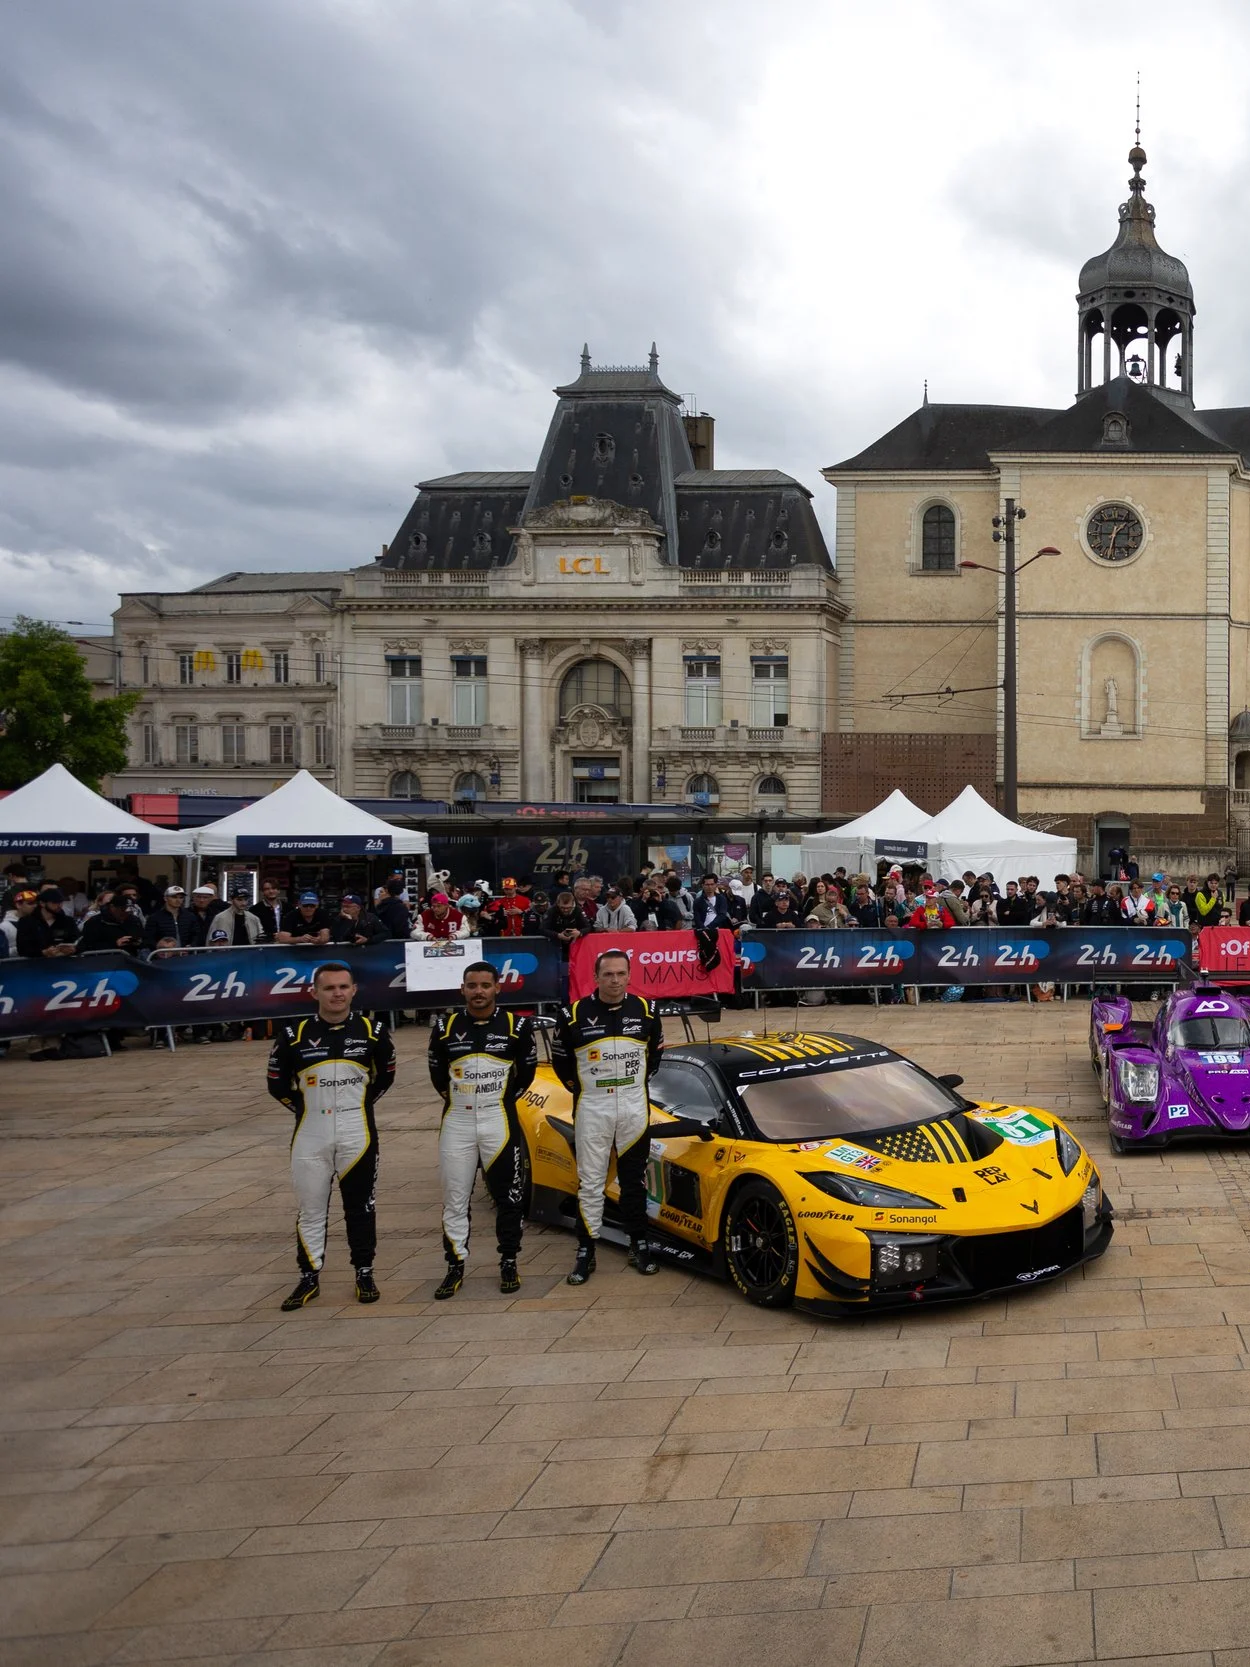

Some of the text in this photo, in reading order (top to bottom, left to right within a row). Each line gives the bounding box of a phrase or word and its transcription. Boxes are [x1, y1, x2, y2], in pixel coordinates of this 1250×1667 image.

[559, 556, 611, 575] LCL
[533, 865, 548, 873] LE
[449, 921, 457, 932] B
[639, 949, 702, 964] cours
[796, 947, 840, 968] 24h
[857, 946, 900, 968] 24h
[938, 945, 979, 967] 24h
[995, 944, 1035, 966] 24h
[1077, 944, 1117, 965] 24h
[1132, 944, 1172, 965] 24h
[183, 971, 246, 1001] 24h
[44, 978, 117, 1011] 24h
[602, 1048, 640, 1061] Sonangol
[1202, 1055, 1241, 1064] 199
[625, 1060, 640, 1069] REP
[738, 1050, 889, 1078] CORVETTE
[464, 1069, 506, 1080] Sonangol
[625, 1068, 640, 1076] LAY
[319, 1075, 364, 1088] Sonangol
[1169, 1106, 1187, 1117] P2
[995, 1119, 1042, 1139] 81
[973, 1166, 1002, 1179] REP
[983, 1172, 1011, 1185] LAY
[659, 1208, 703, 1233] GOODYEAR
[778, 1200, 796, 1245] EAGLE
[797, 1210, 855, 1222] GOODYEAR
[889, 1213, 938, 1226] Sonangol
[1033, 1264, 1061, 1275] SPORT
